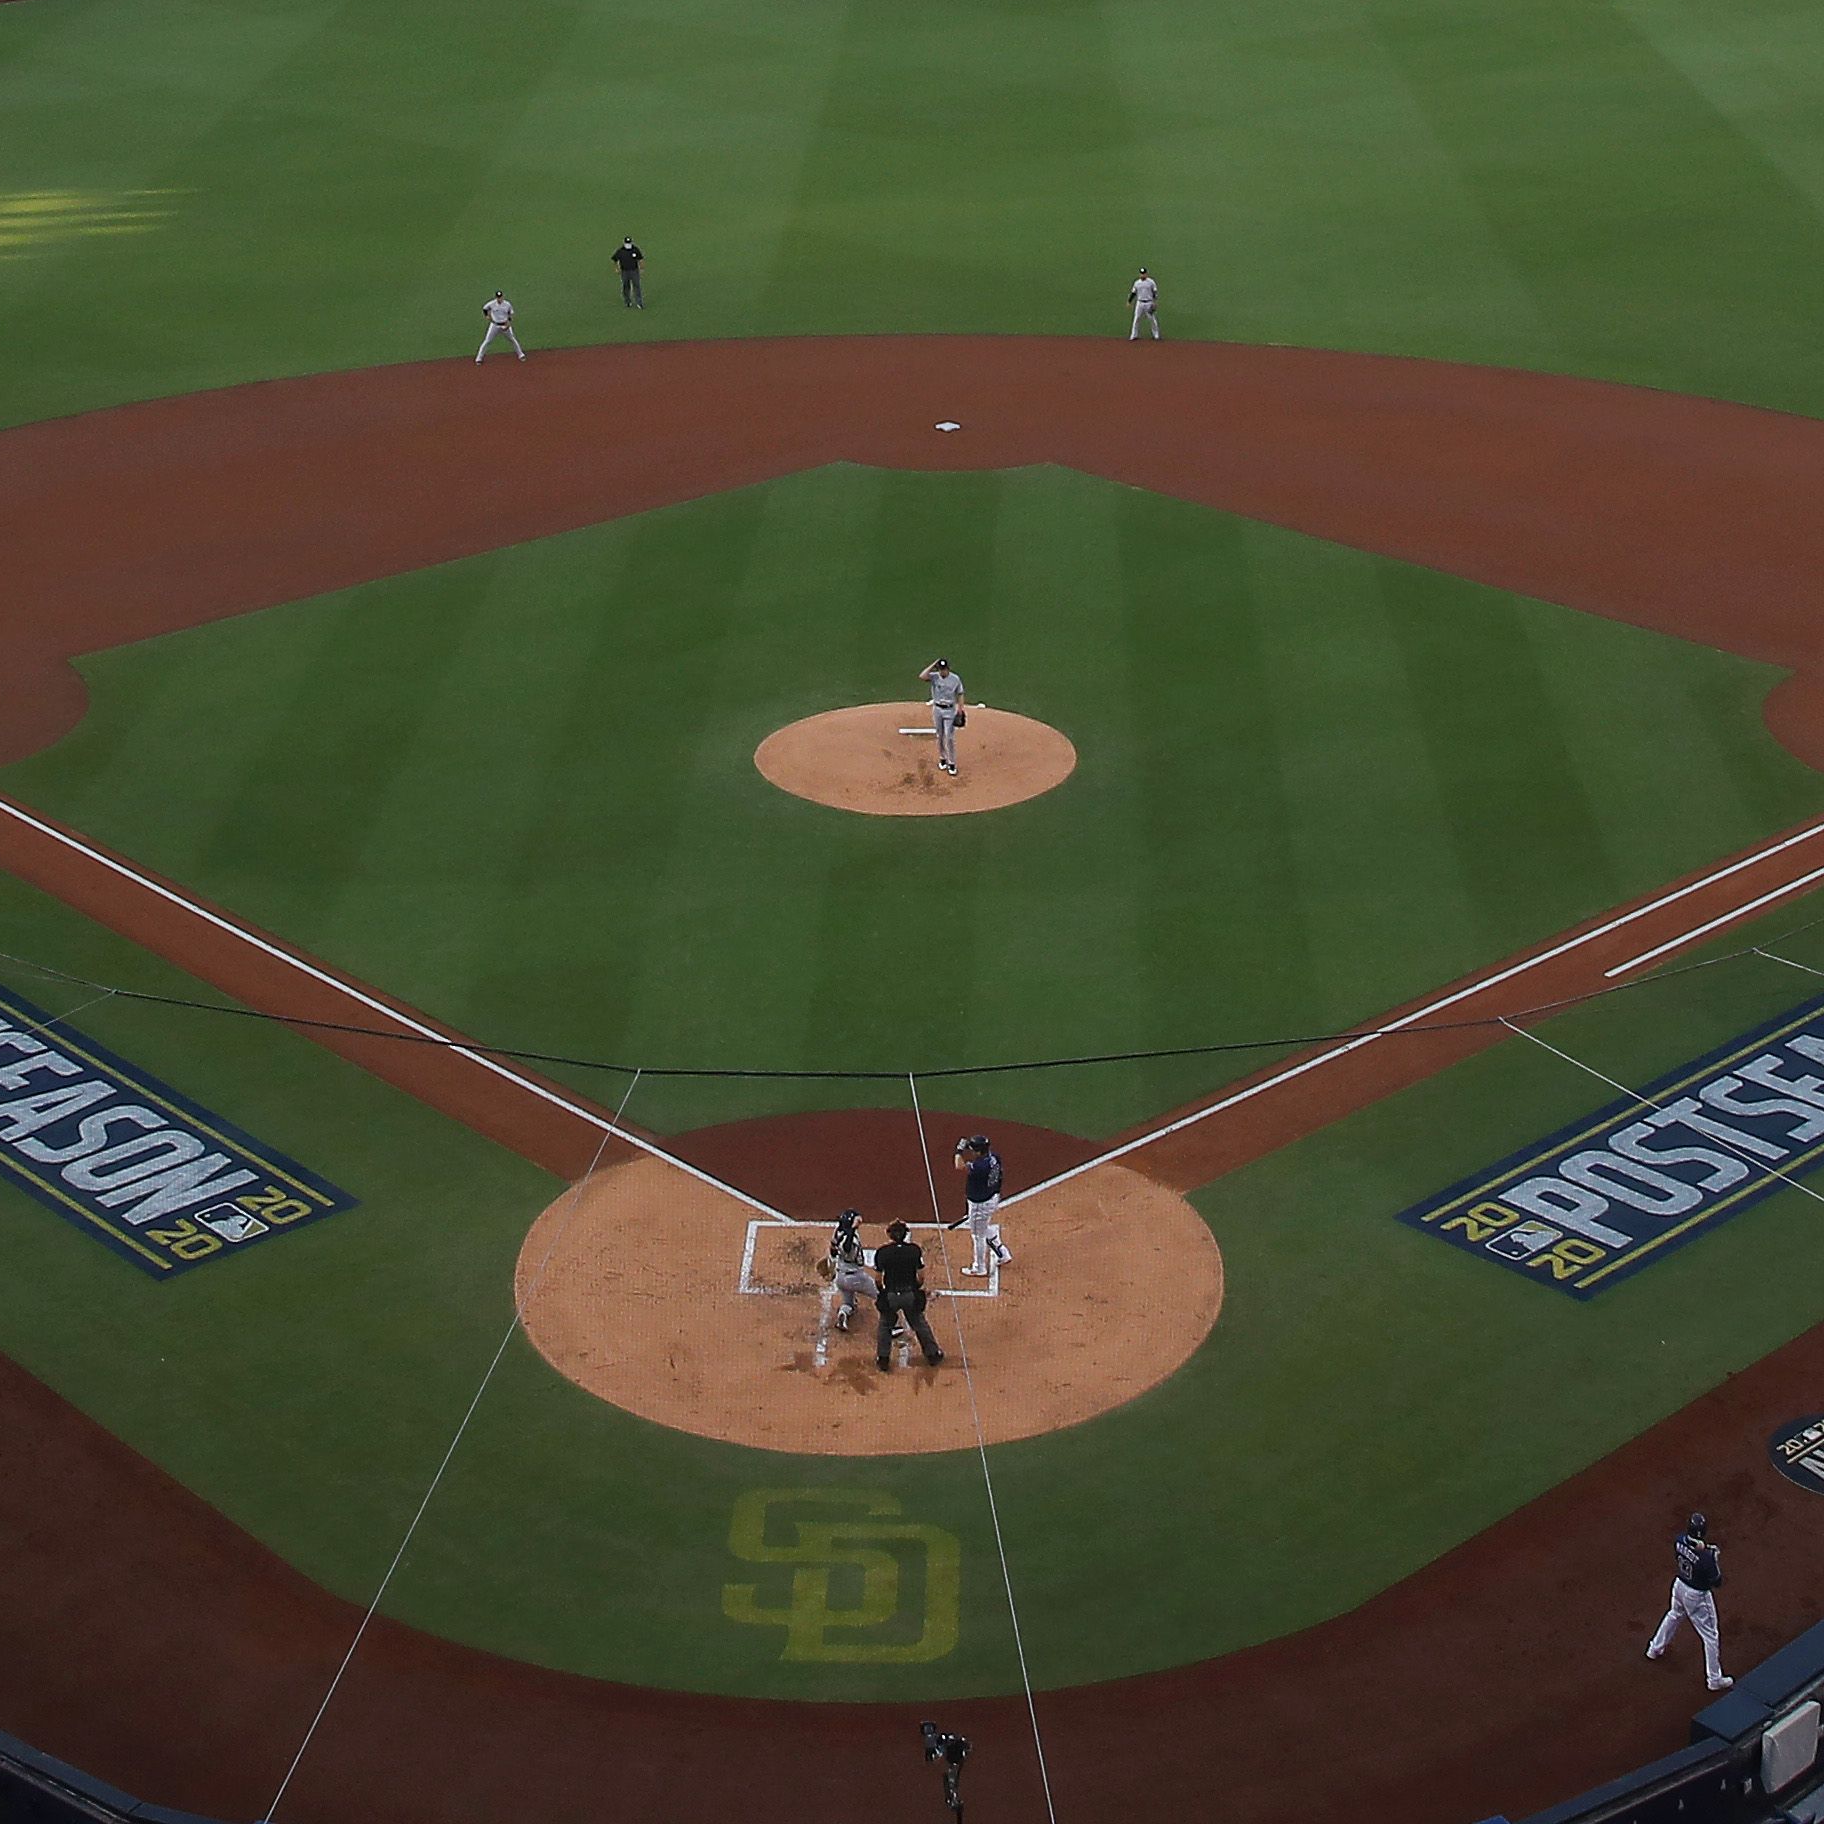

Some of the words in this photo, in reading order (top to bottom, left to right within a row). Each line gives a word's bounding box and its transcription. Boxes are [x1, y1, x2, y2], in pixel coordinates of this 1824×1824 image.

[235, 1186, 313, 1226] 20
[1441, 1201, 1519, 1242] 20
[146, 1219, 223, 1261] 20
[1528, 1238, 1607, 1280] 20
[721, 1487, 962, 1664] SD
